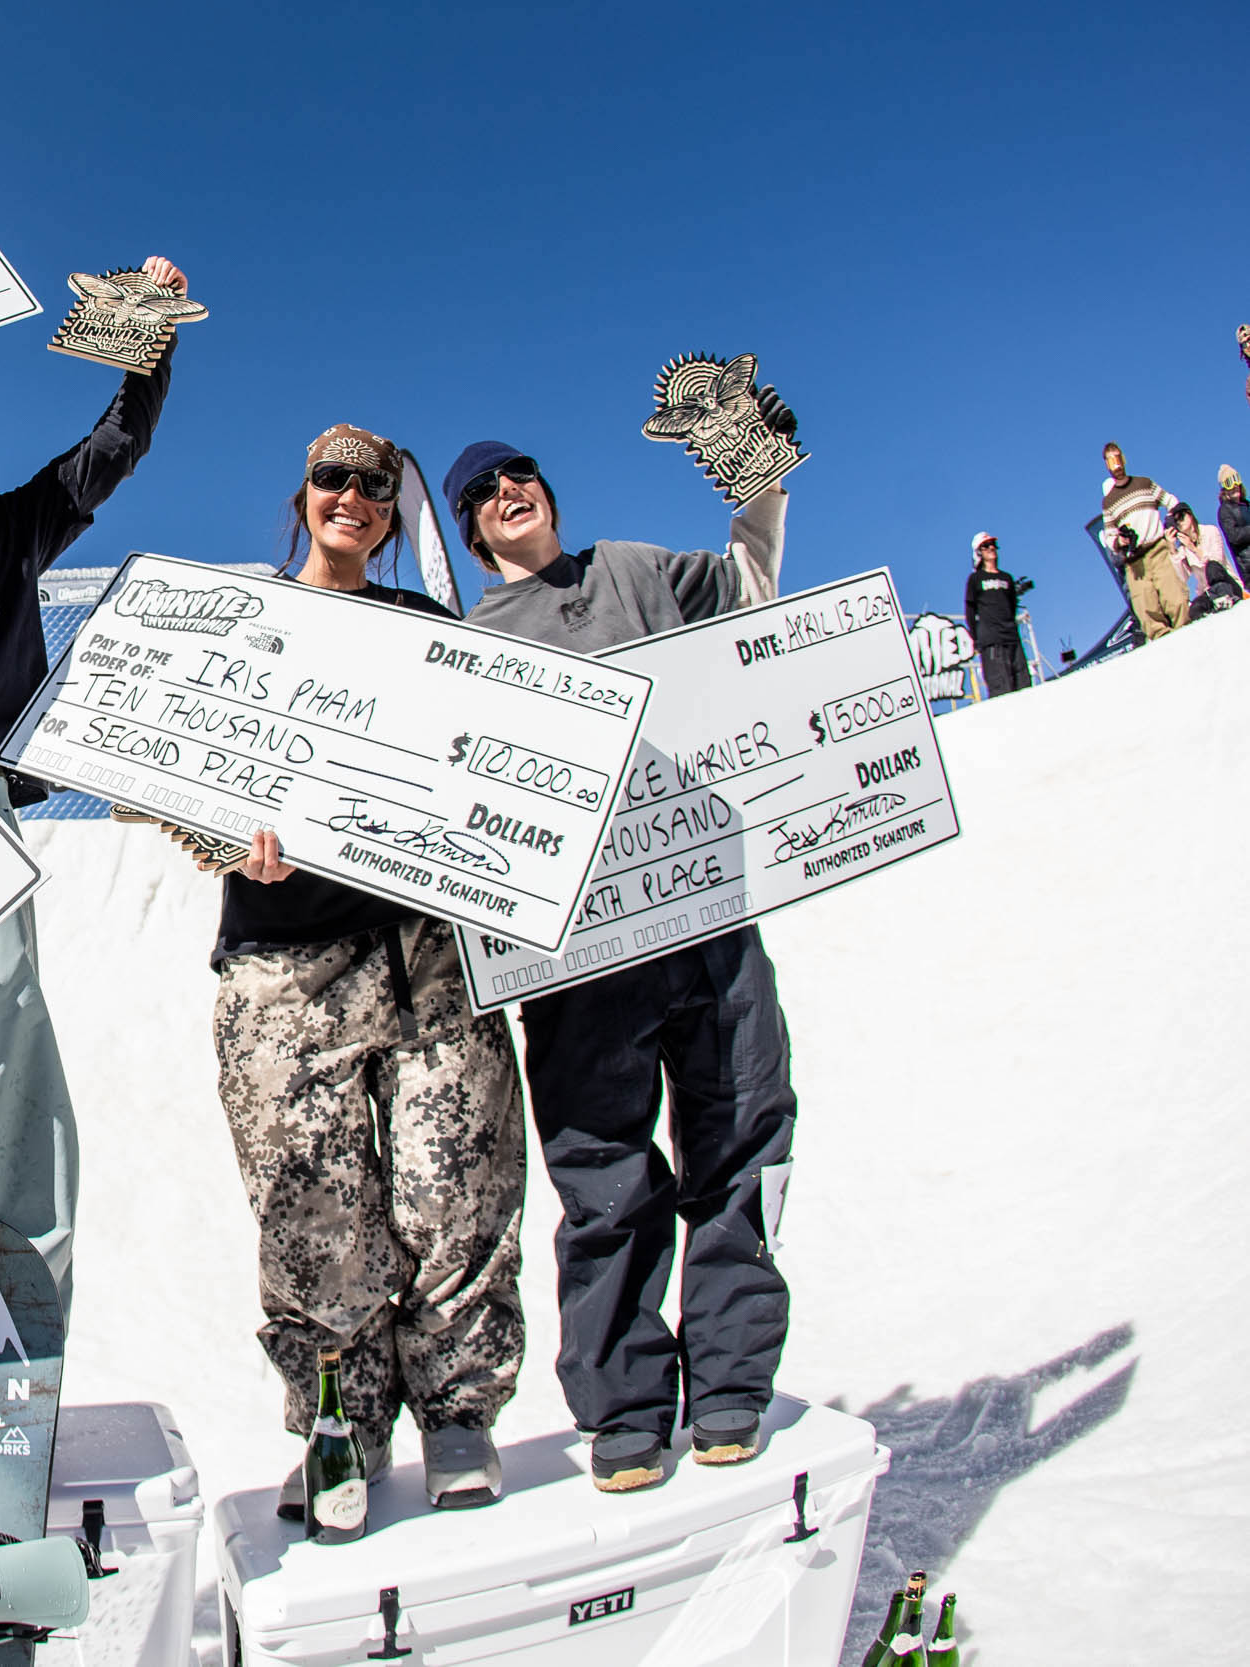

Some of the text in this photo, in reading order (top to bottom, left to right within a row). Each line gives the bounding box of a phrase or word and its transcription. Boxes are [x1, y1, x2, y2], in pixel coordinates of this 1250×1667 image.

[73, 320, 156, 343] UNINVITED
[115, 580, 264, 619] UNINVITED
[142, 615, 237, 637] INVITATIONAL
[244, 635, 272, 646] NORTH
[249, 642, 270, 651] FACE
[259, 632, 274, 641] THE
[735, 633, 785, 667] DATE:
[785, 611, 833, 650] APRIL
[79, 651, 155, 679] ORDER OF:
[89, 634, 173, 666] PAY TO THE
[425, 640, 483, 676] DATE:
[485, 653, 545, 689] APRIL
[186, 650, 376, 731] IRIS PHAM
[83, 673, 314, 763] TEN THOUSAND
[808, 710, 826, 747] $
[35, 711, 294, 804] FOR SECOND PLACE
[448, 732, 472, 766] $
[674, 722, 780, 789] WARNER
[855, 746, 921, 789] DOLLARS
[466, 803, 564, 857] DOLLARS
[602, 793, 732, 866] HOUSAND
[803, 819, 926, 879] AUTHORIZED SIGNATURE
[338, 842, 518, 917] AUTHORIZED SIGNATURE
[642, 855, 723, 904] PLACE
[573, 1591, 632, 1621] YETI
